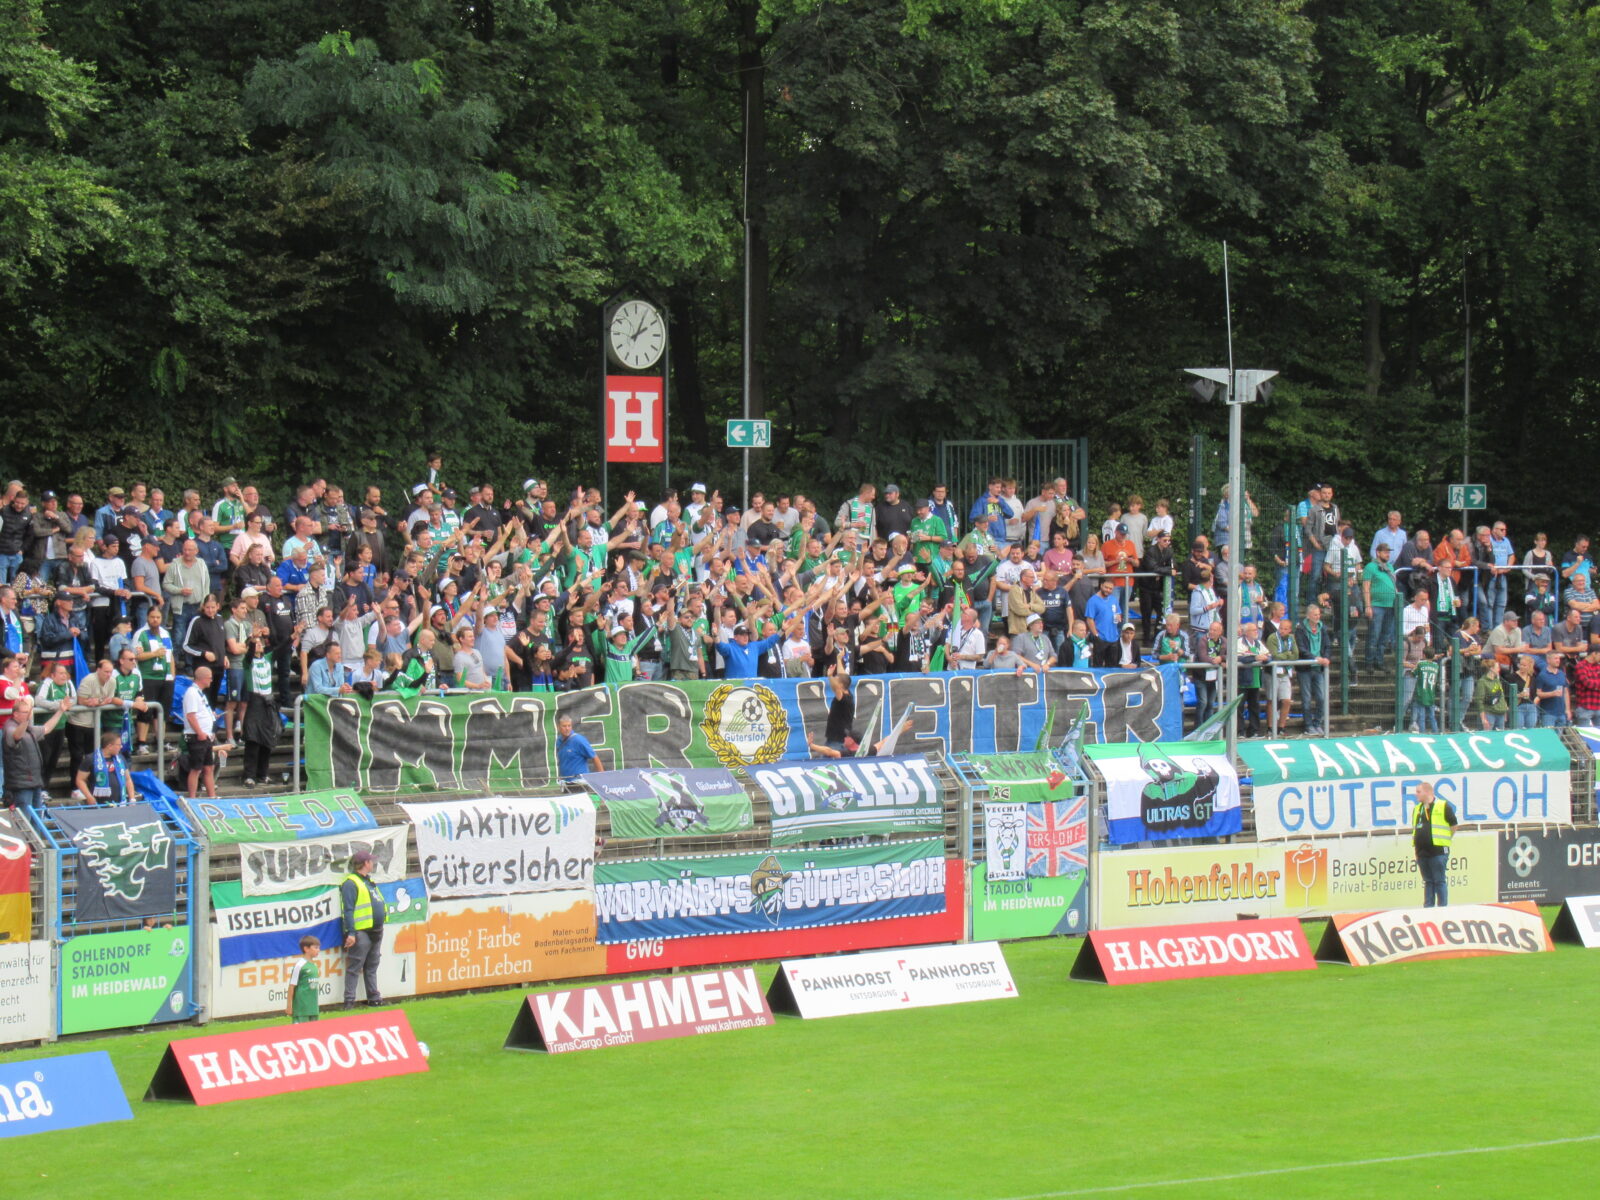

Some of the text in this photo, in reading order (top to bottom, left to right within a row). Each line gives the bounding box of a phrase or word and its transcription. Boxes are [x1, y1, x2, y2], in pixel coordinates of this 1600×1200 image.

[327, 682, 693, 792] IMMER
[724, 732, 766, 742] Gütersloh
[1263, 733, 1541, 779] FANATICS
[755, 759, 938, 816] GT LEBT
[1146, 803, 1213, 823] ULTRAS GT
[1277, 773, 1548, 831] GÜTERSLOH
[199, 795, 368, 835] RHEDA
[455, 805, 552, 841] Aktive
[423, 847, 595, 889] Gütersloher
[595, 855, 945, 924] VORWÄRTS GÜTERSLOH
[983, 882, 1032, 896] STADION
[1127, 862, 1280, 908] Hohenfelder
[1333, 877, 1417, 894] Privat-Brauerei
[1507, 880, 1540, 889] elements
[228, 898, 332, 931] ISSELHORST
[983, 896, 1065, 911] IM HEIDEWALD
[477, 927, 521, 950] Farbe
[576, 927, 589, 935] und
[1350, 915, 1539, 964] Kleinemas
[32, 954, 45, 966] für
[72, 943, 152, 963] OHLENDORF
[544, 945, 595, 957] vom Fachmann
[626, 940, 664, 960] GWG
[1104, 930, 1300, 972] HAGEDORN
[72, 961, 130, 979] STADION
[426, 955, 532, 983] in dein Leben
[908, 961, 996, 982] PANNHORST
[71, 975, 167, 998] IM HEIDEWALD
[801, 971, 893, 992] PANNHORST
[956, 979, 1002, 991] ENTSORGUNG
[536, 967, 764, 1042] KAHMEN
[849, 989, 897, 1001] ENTSORGUNG
[695, 1015, 767, 1035] www.kahmen.de
[548, 1031, 634, 1054] TransCargo GmbH
[189, 1025, 410, 1090] HAGEDORN
